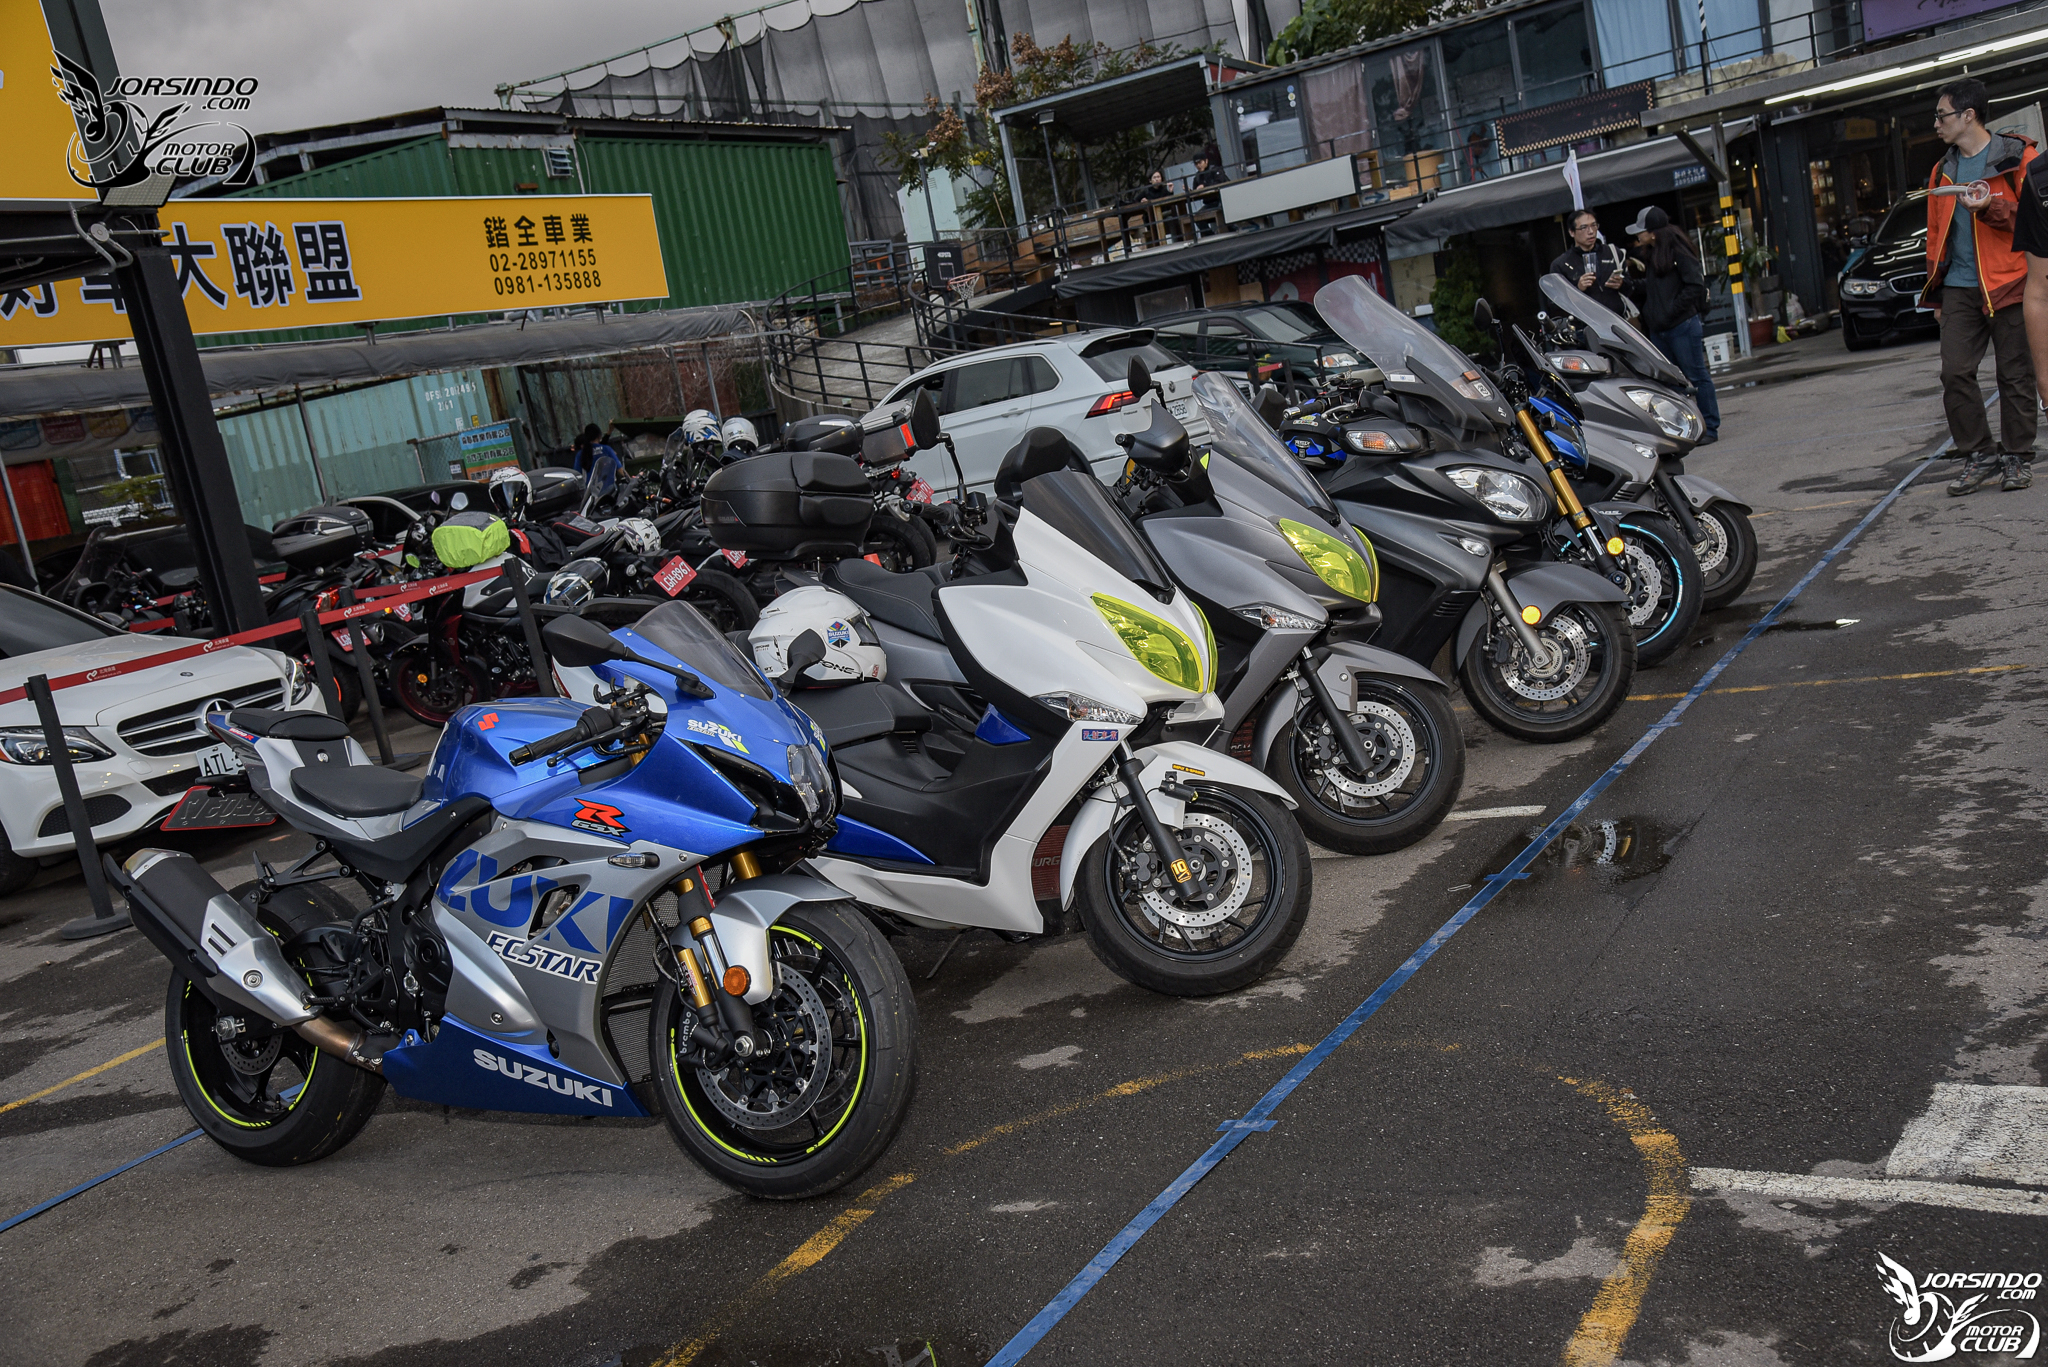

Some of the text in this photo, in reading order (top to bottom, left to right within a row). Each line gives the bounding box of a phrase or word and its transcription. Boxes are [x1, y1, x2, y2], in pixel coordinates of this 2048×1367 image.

[489, 248, 597, 273] 02-28971155
[494, 270, 602, 296] 0981-135888
[659, 561, 692, 592] LGH-8967
[687, 719, 743, 743] SUZUKI
[571, 819, 624, 838] GSX
[486, 930, 605, 985] ECSTAR
[679, 1011, 692, 1054] brembo
[472, 1048, 613, 1108] SUZUKI
